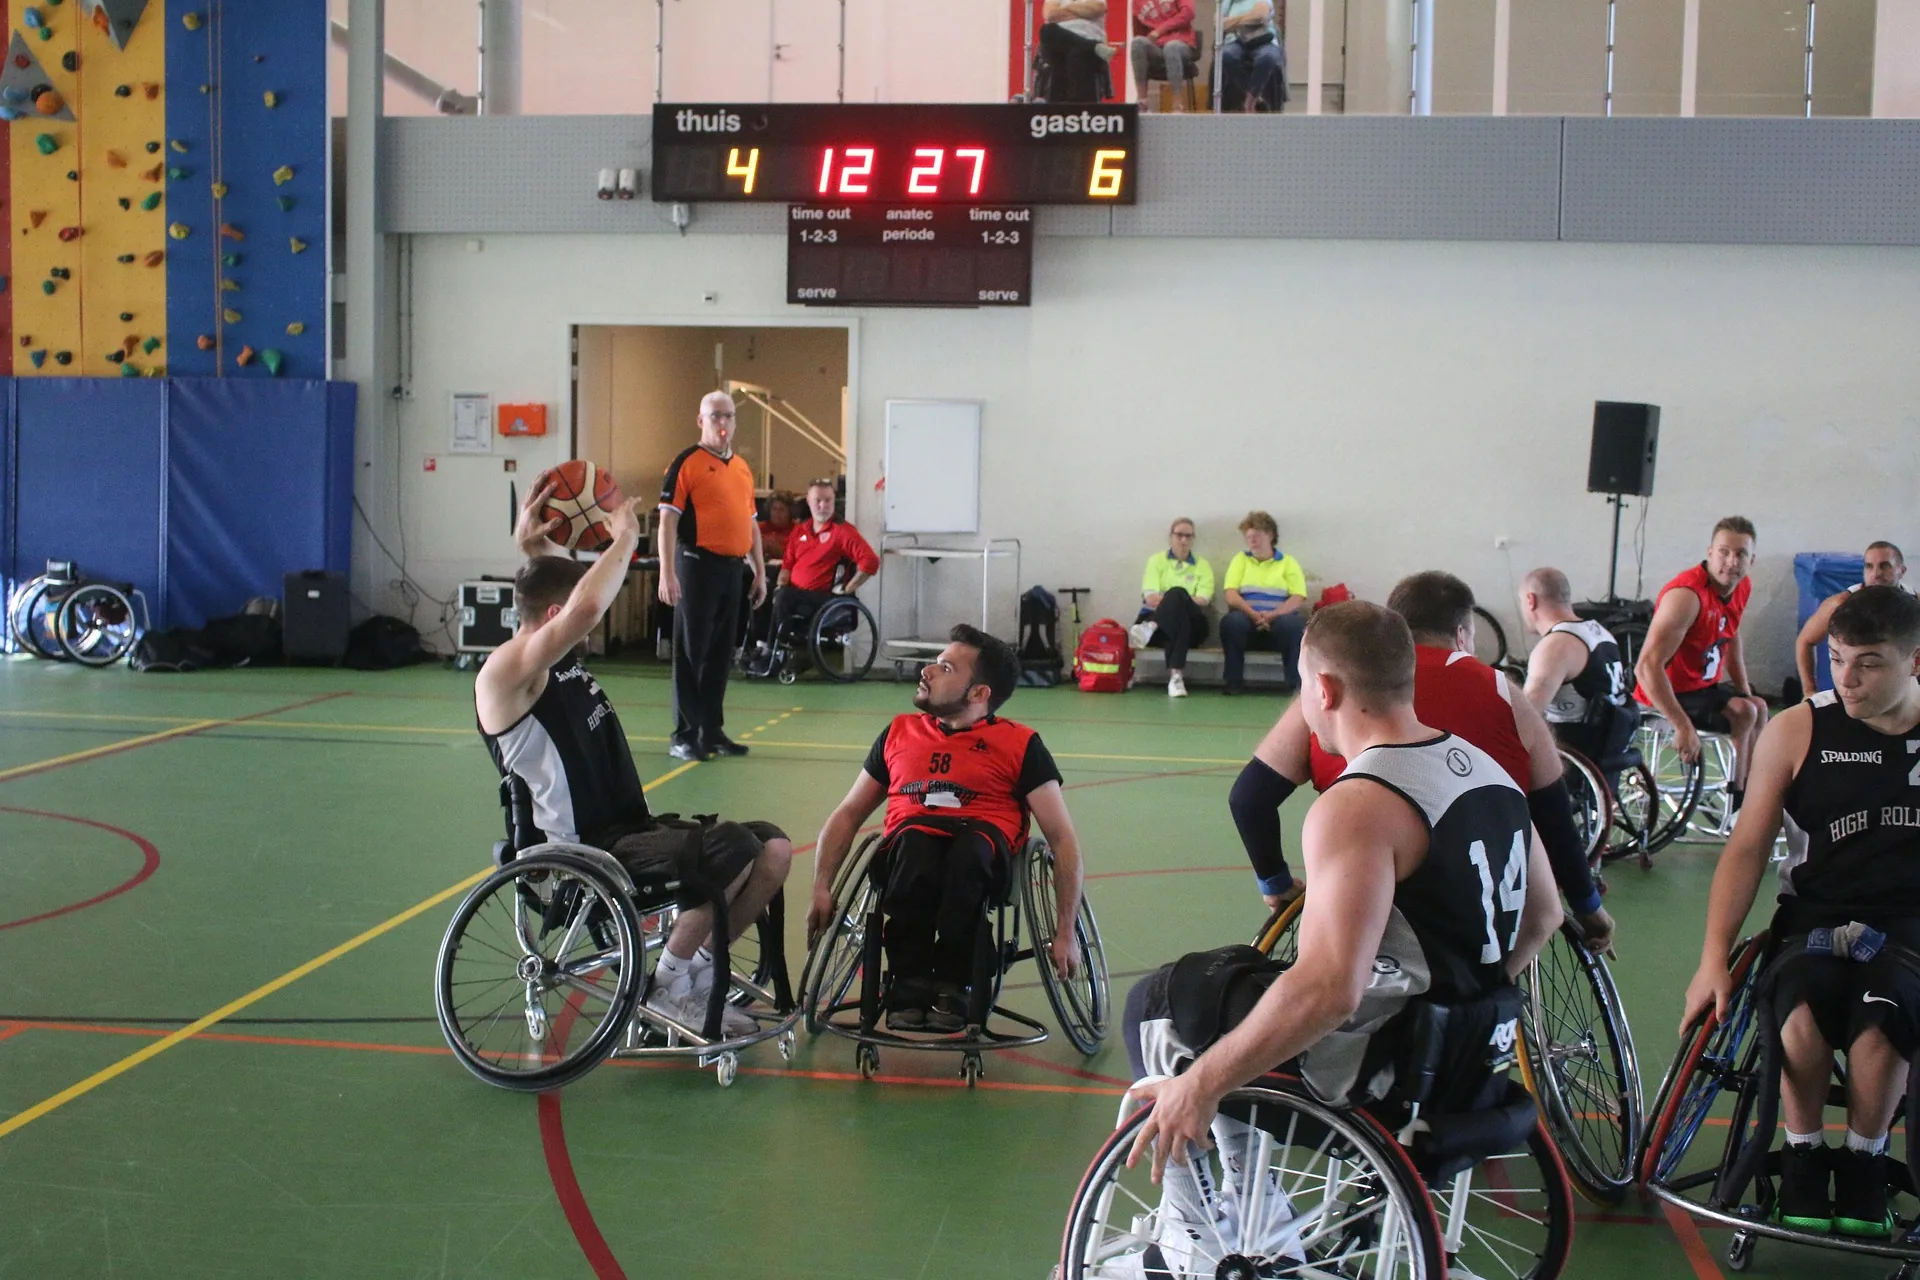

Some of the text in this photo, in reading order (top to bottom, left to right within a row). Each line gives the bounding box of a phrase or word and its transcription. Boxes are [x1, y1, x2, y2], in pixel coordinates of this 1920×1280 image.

[675, 109, 741, 132] thuis
[1030, 111, 1124, 138] gasten
[726, 148, 759, 193] 4
[818, 148, 985, 194] 12 27
[1088, 150, 1126, 196] 6
[792, 207, 851, 220] time out
[886, 208, 934, 220] anatec
[969, 208, 1030, 221] time out
[800, 229, 838, 242] 1-2-3
[882, 228, 936, 242] periode
[982, 230, 1020, 244] 1-2-3
[797, 287, 837, 298] serve
[978, 289, 1019, 300] serve
[928, 752, 952, 774] 58
[1821, 750, 1882, 764] SPALDING
[1829, 810, 1869, 842] HIGH
[1469, 829, 1527, 964] 14
